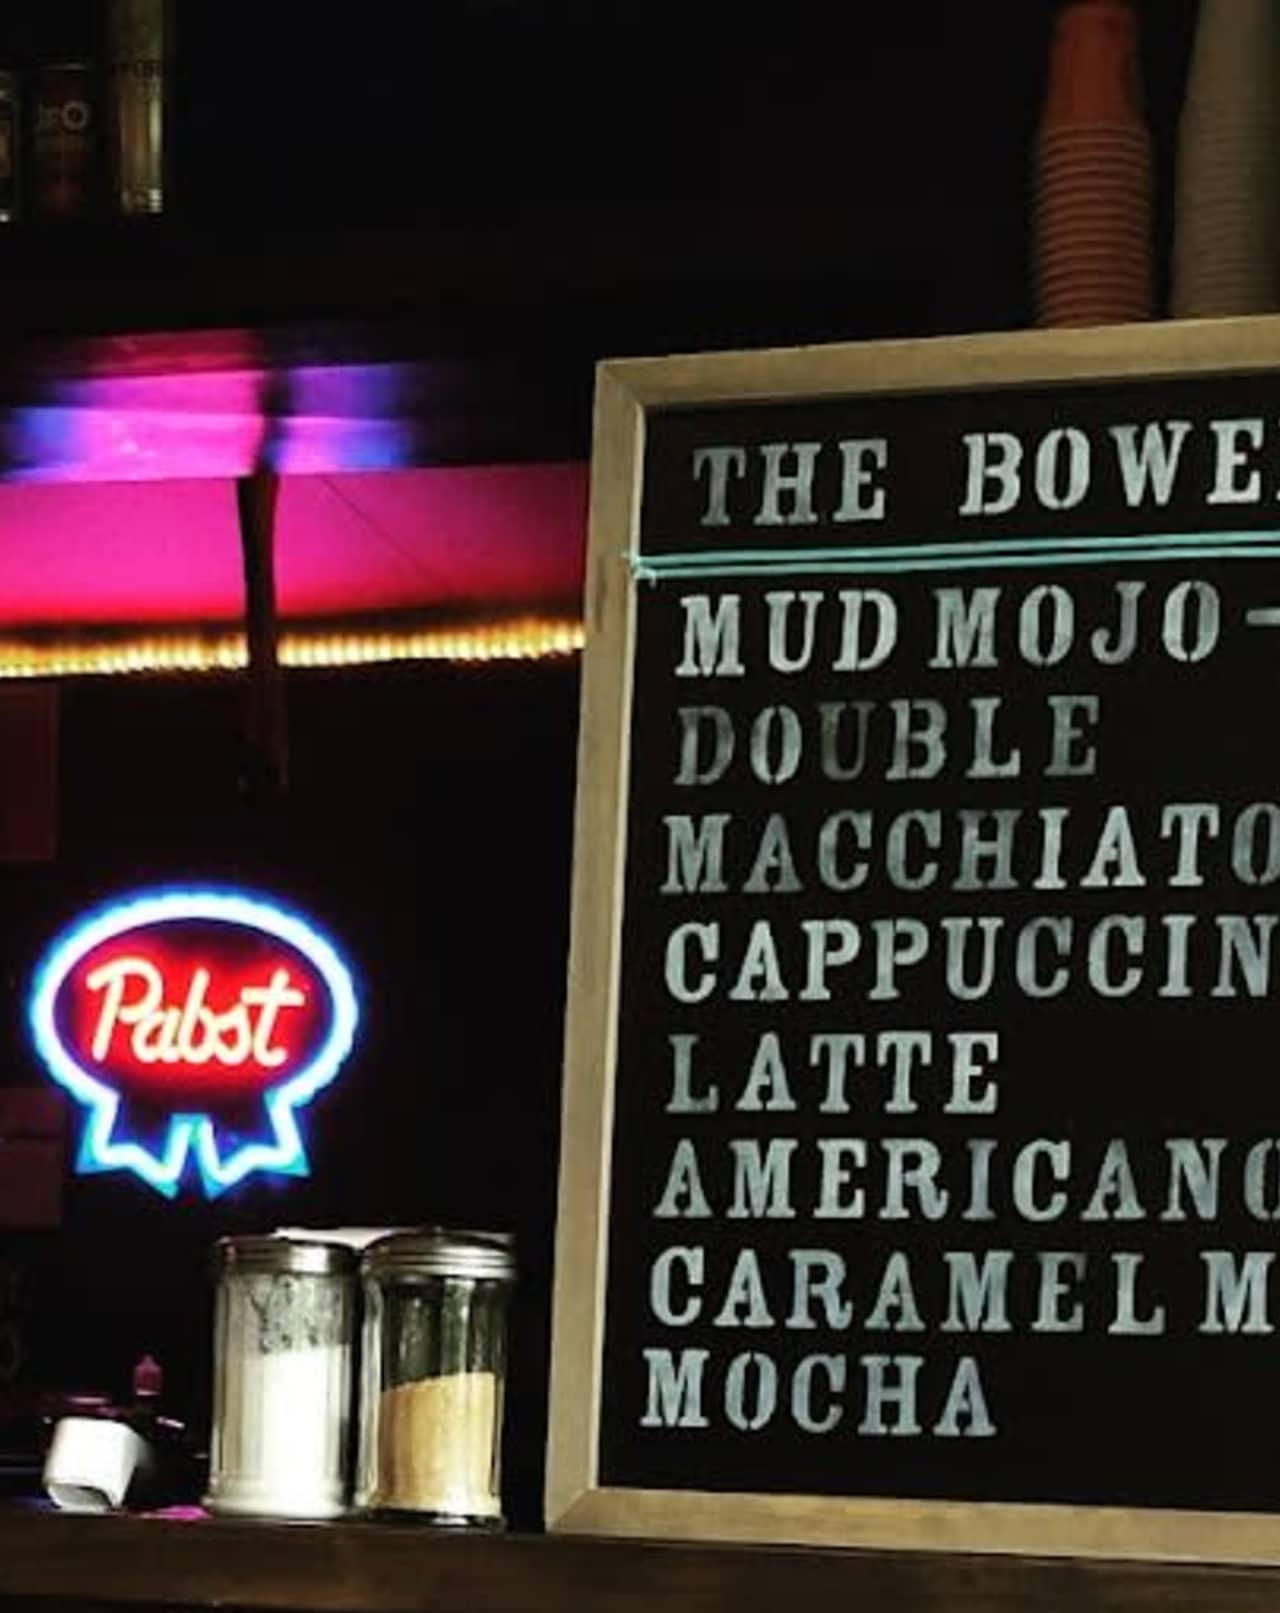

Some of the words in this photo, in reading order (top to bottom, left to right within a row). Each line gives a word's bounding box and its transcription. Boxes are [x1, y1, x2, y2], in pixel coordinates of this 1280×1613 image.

[691, 438, 889, 529] THE
[673, 588, 900, 679] MUD
[672, 695, 1101, 786] DOUBLE
[86, 955, 305, 1068] Pabst
[664, 1031, 1000, 1116] LATTE
[648, 1245, 1166, 1337] CARAMEL
[638, 1347, 999, 1438] MOCHA
